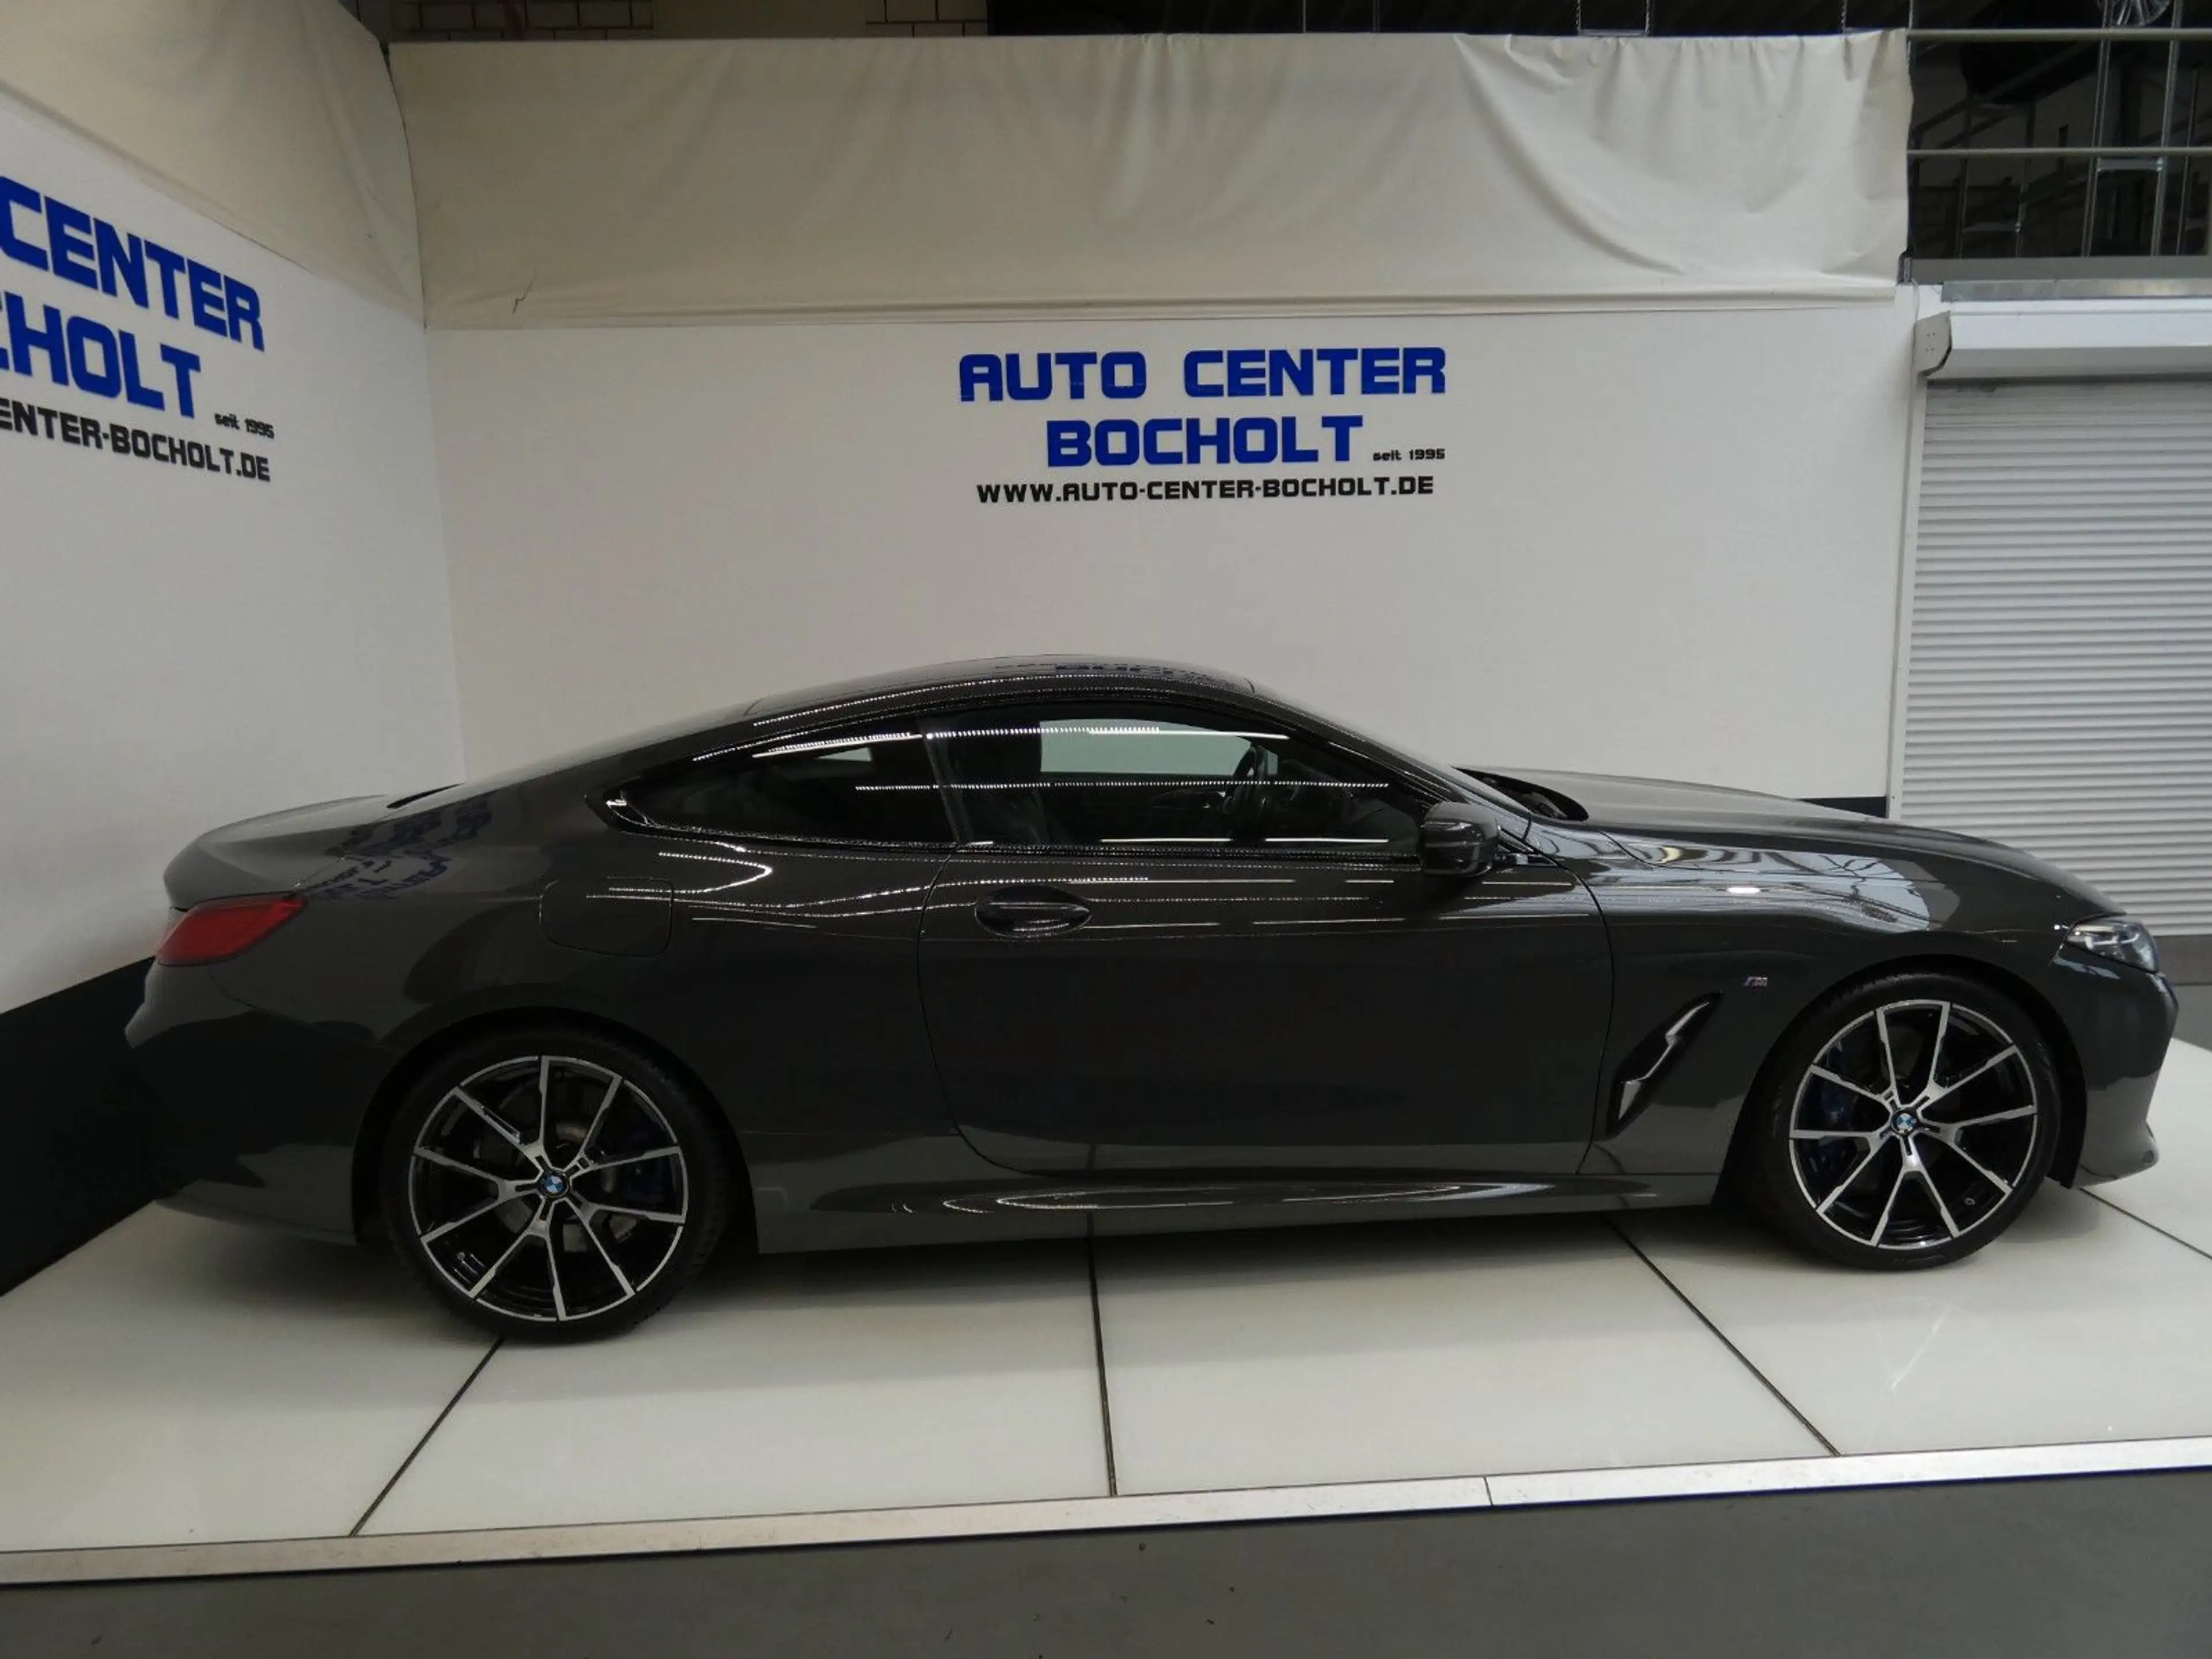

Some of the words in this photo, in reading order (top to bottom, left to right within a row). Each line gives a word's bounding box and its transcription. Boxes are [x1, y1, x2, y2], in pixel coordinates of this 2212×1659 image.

[0, 176, 264, 352] CENTER
[0, 291, 202, 419] HOLT
[214, 413, 240, 430] seit
[244, 418, 275, 440] 1995
[960, 351, 1147, 402] AUTO
[1184, 347, 1446, 398] CENTER
[1047, 415, 1364, 467] BOCHOLT
[1373, 449, 1402, 461] seit
[1409, 448, 1446, 460] 1995
[976, 475, 1433, 503] WWW.AUTO-CENTER-BOCHOLT.DE
